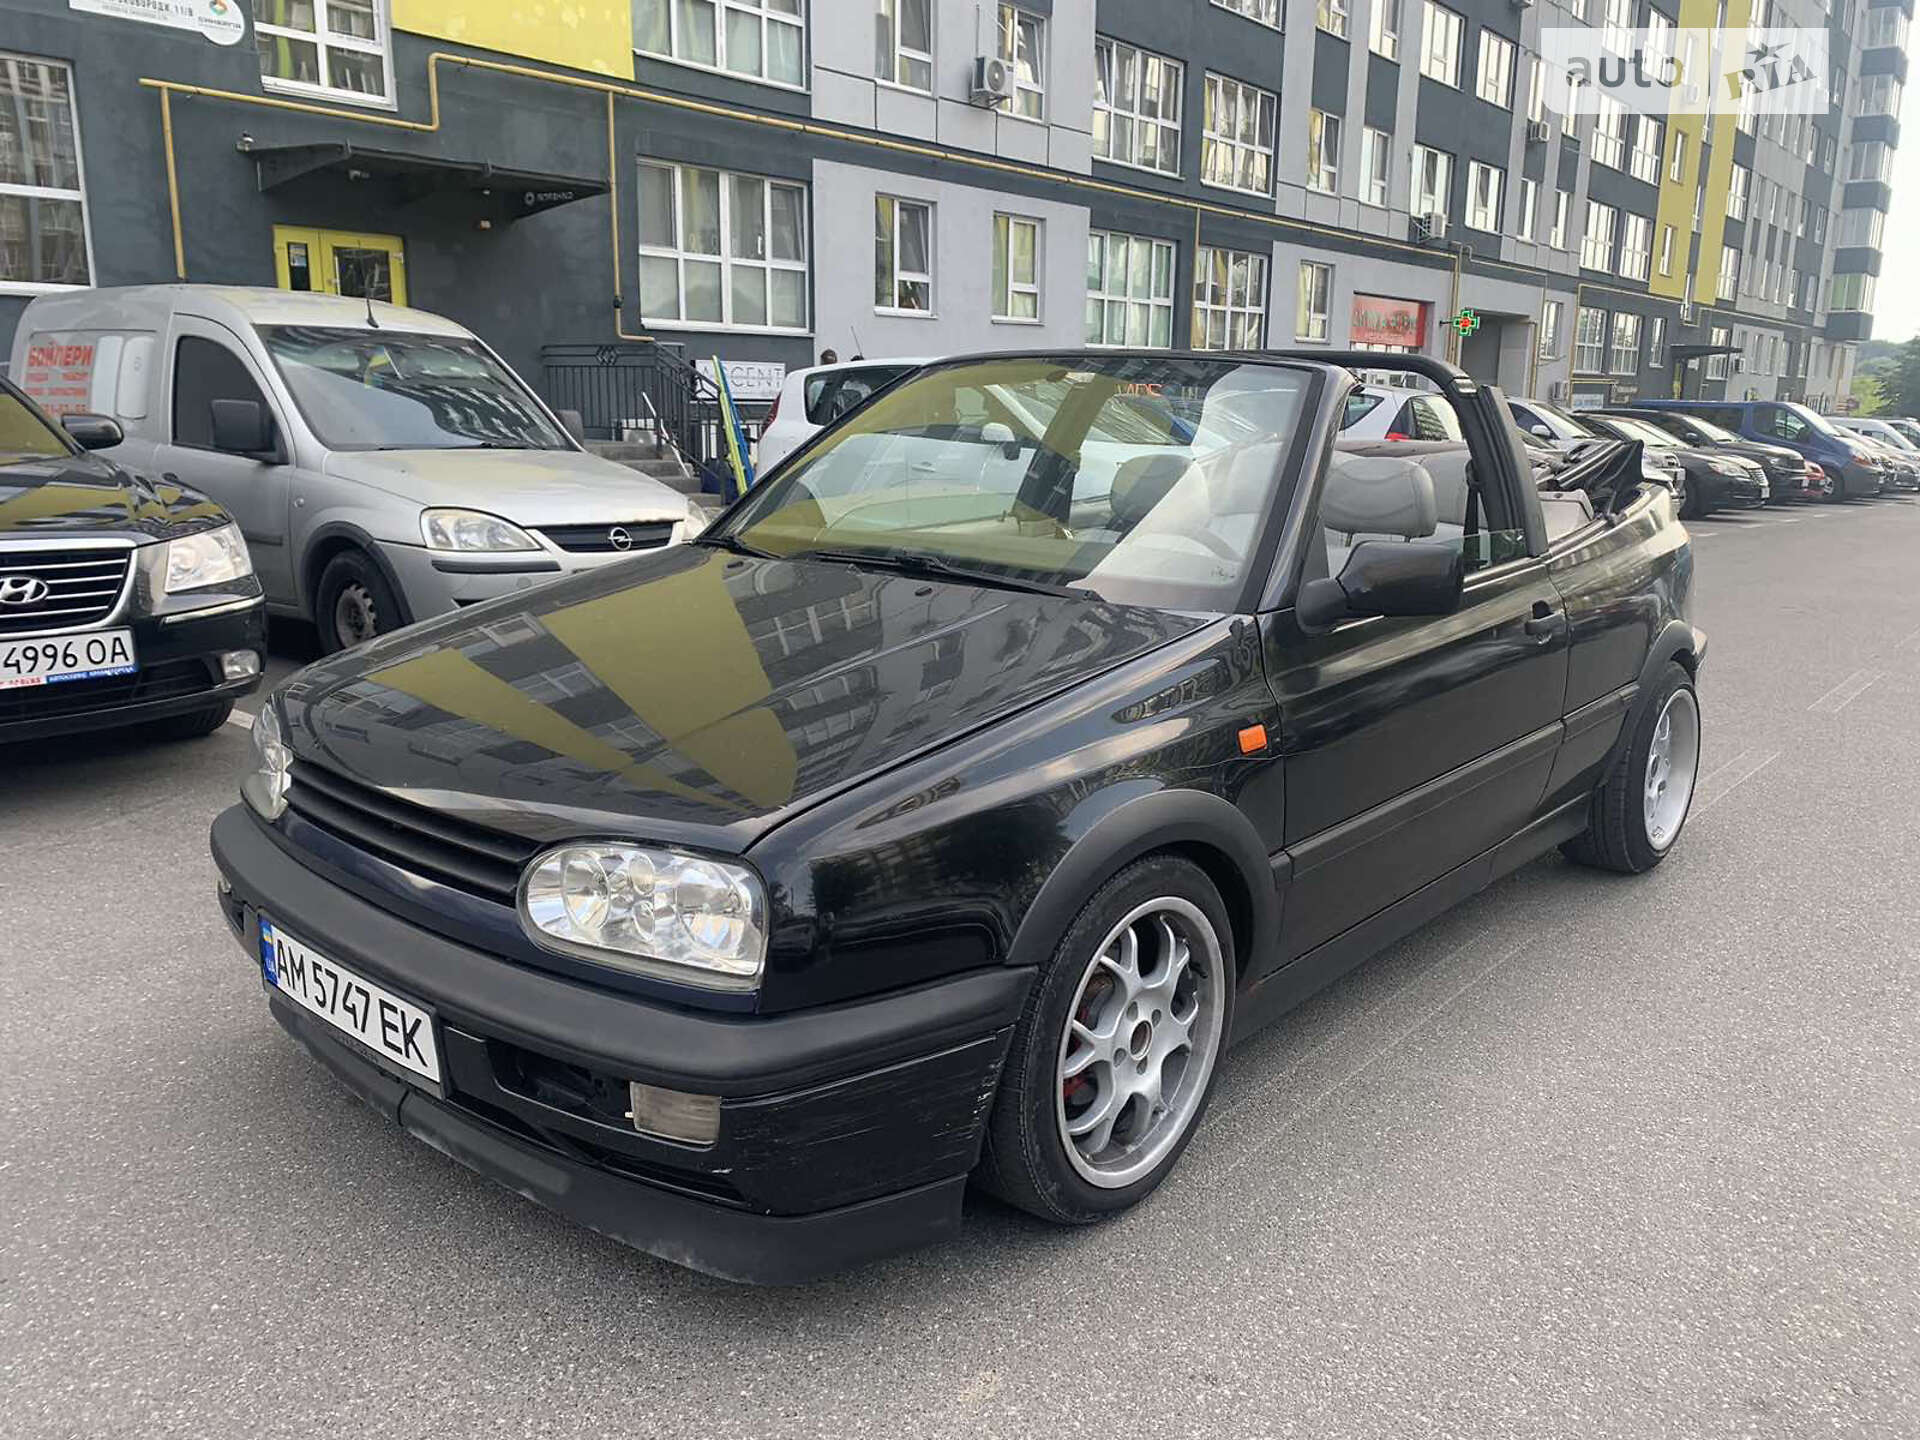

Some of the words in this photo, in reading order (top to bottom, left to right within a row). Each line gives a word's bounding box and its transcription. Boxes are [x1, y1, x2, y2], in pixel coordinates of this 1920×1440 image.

[3, 641, 78, 674] 4996
[86, 637, 130, 665] OA
[276, 938, 308, 999] AM
[311, 960, 372, 1034] 5747
[378, 997, 429, 1068] EK
